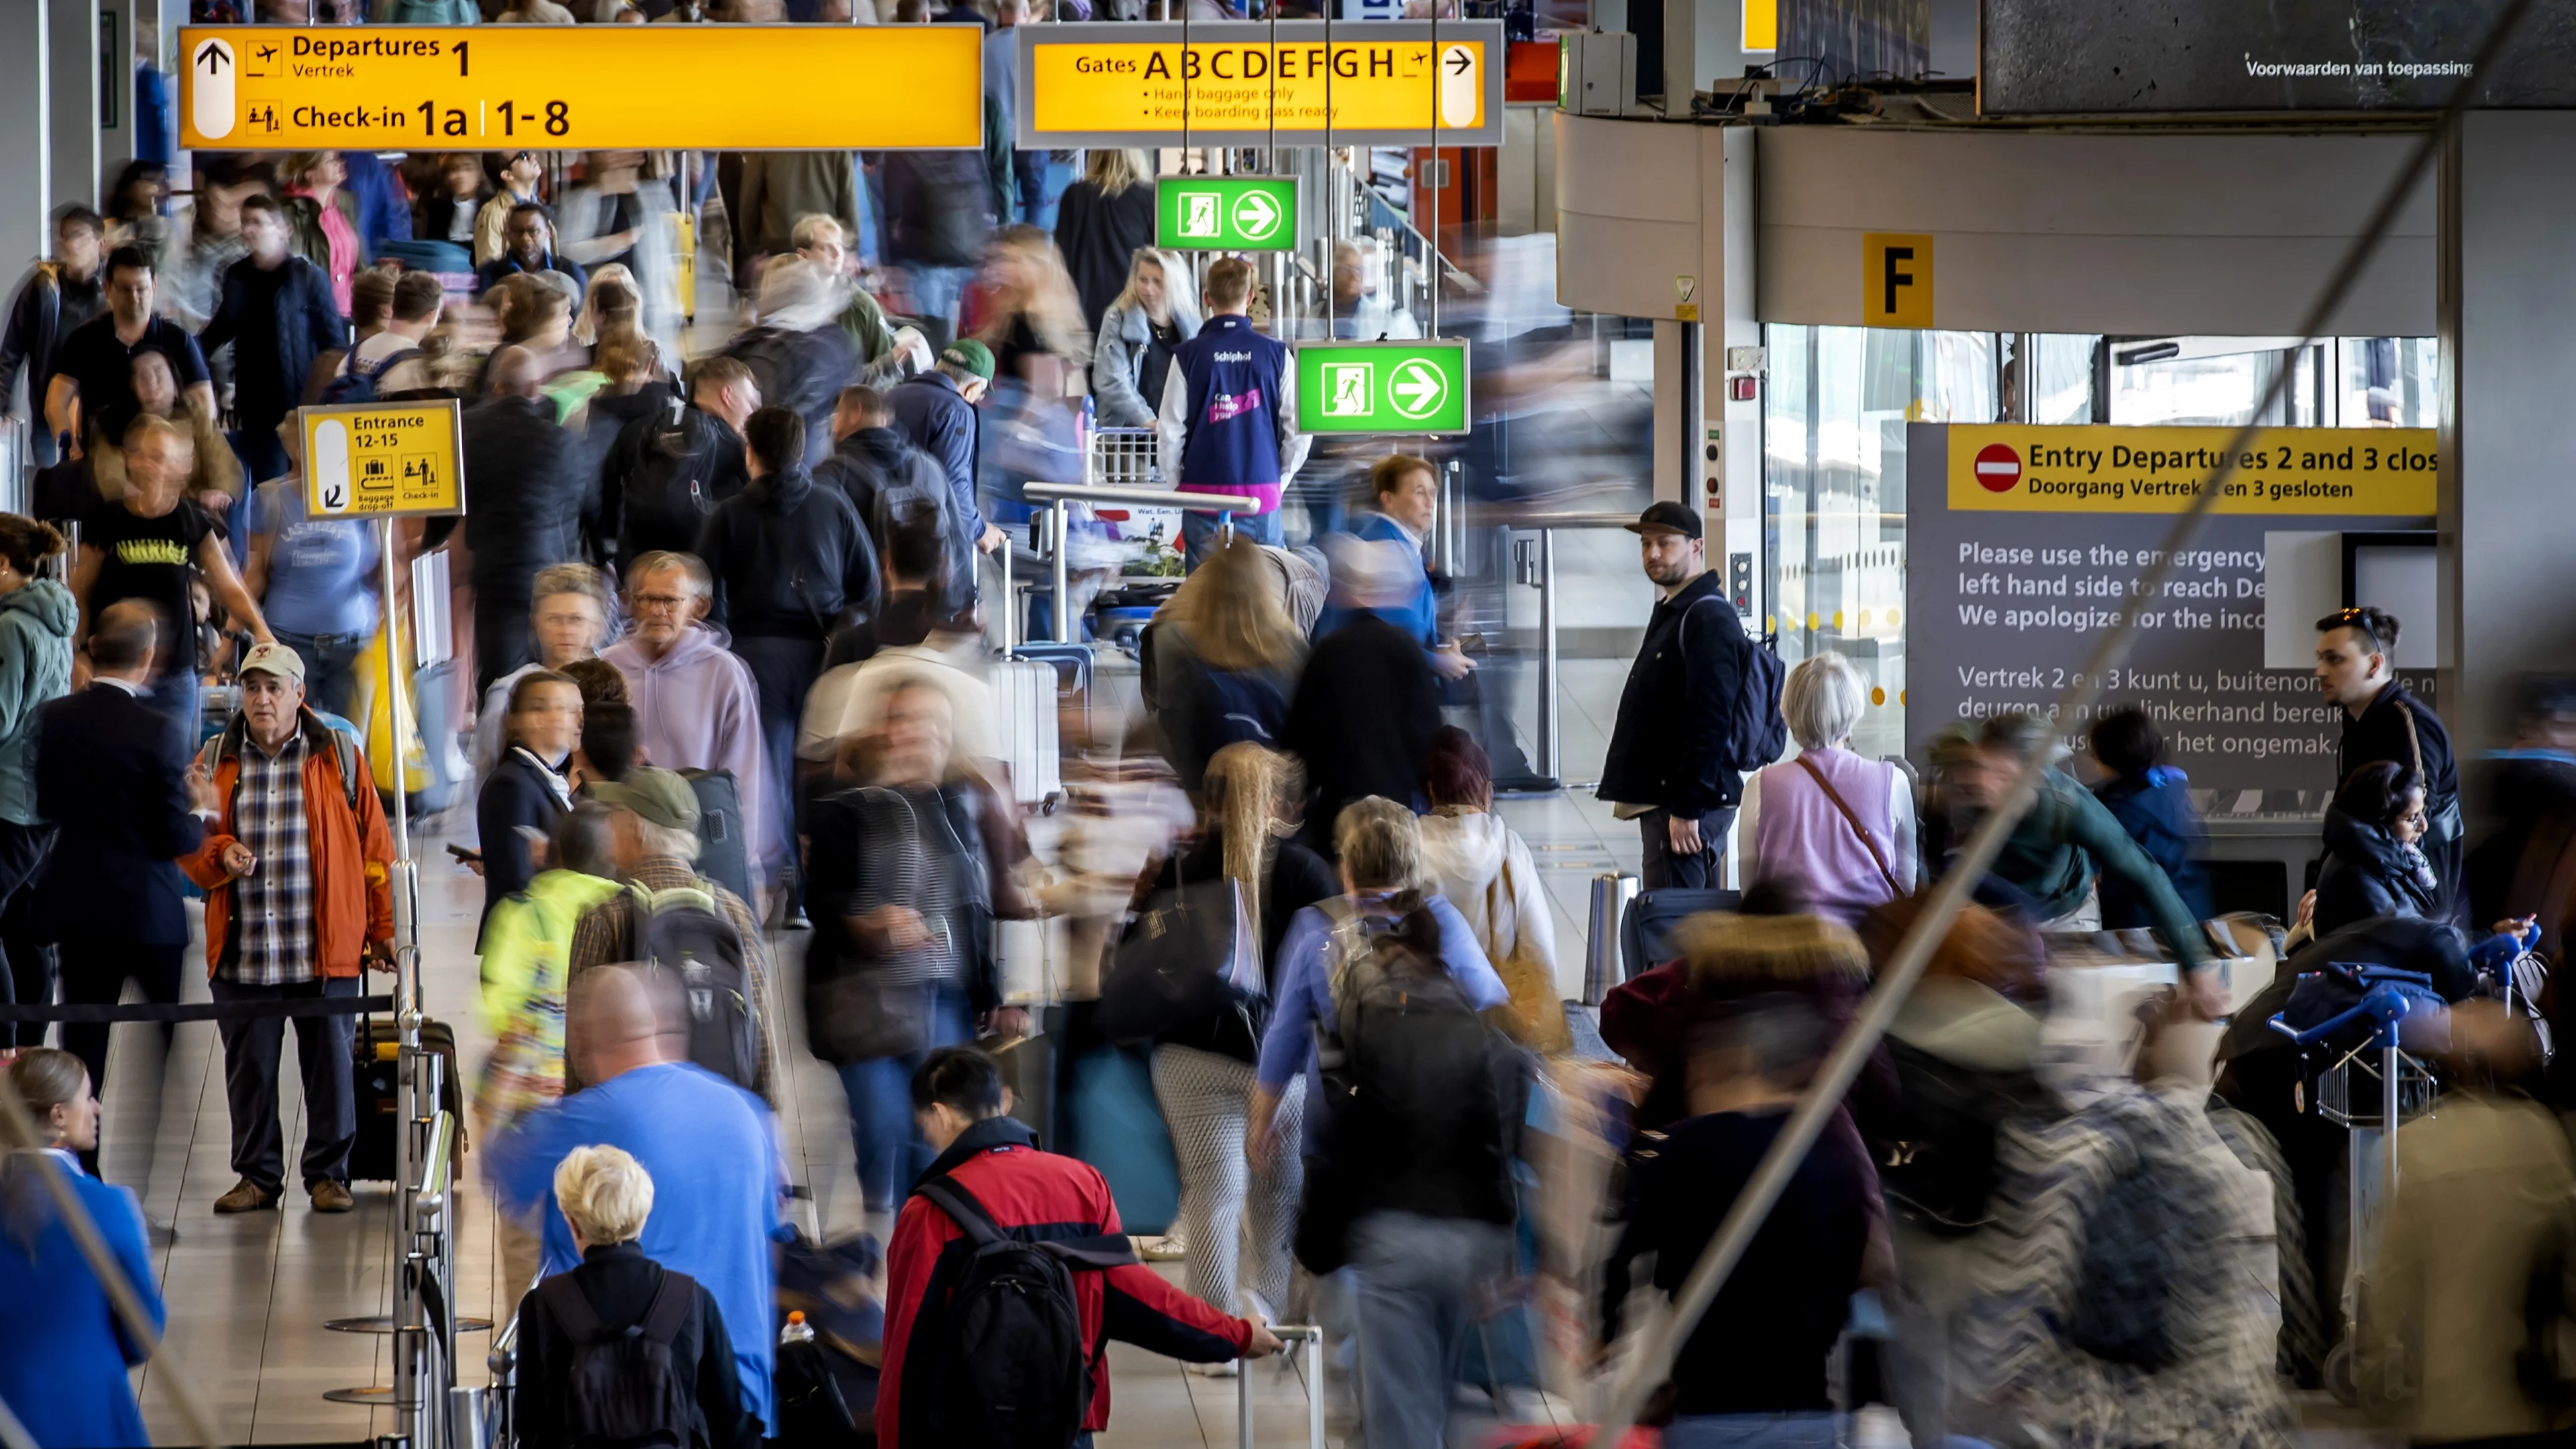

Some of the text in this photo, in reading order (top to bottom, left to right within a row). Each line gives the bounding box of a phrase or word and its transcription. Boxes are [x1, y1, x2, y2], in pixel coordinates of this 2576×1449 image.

[293, 36, 469, 76] Departures 1
[1076, 56, 1137, 74] Gates
[293, 64, 355, 78] Vertrek
[2247, 60, 2474, 78] Voorwaarden van toepassing
[1197, 87, 1259, 102] baggage
[1264, 86, 1294, 103] only
[293, 107, 405, 128] Check-in
[417, 101, 468, 136] 1a
[1155, 106, 1190, 121] Keep
[1195, 105, 1259, 121] boarding
[1265, 107, 1294, 121] pass
[1885, 246, 1914, 314] F
[1214, 351, 1251, 364] Schiphol
[1214, 393, 1232, 402] Can
[1220, 401, 1238, 411] help
[354, 416, 425, 431] Entrance
[1214, 411, 1232, 421] you
[356, 433, 398, 448] 12-15
[2029, 444, 2103, 474] Entry
[2277, 447, 2293, 470] 2
[2301, 447, 2353, 470] and
[2363, 447, 2378, 470] 3
[403, 491, 439, 500] Check-in
[2029, 478, 2125, 500] Doorgang
[2131, 479, 2201, 496] Vertrek
[2224, 484, 2247, 496] en
[2253, 480, 2264, 496] 3
[2269, 480, 2353, 500] gesloten
[358, 494, 394, 503] Baggage
[1958, 542, 2265, 573] Please use the emergency
[1958, 572, 2000, 595] left
[2007, 573, 2067, 596] hand
[2074, 575, 2123, 597] side
[2130, 578, 2155, 597] to
[2163, 576, 2228, 598] reach
[1958, 605, 1997, 625] We
[2004, 605, 2122, 633] apologize
[2173, 607, 2212, 629] the
[1958, 666, 2044, 689] Vertrek
[2051, 668, 2065, 689] 2
[2108, 669, 2120, 690] 3
[2129, 667, 2181, 690] kunt
[1958, 696, 2040, 718] deuren
[2141, 698, 2265, 723] linkerhand
[2178, 731, 2215, 753] het
[2222, 733, 2339, 759] ongemak.
